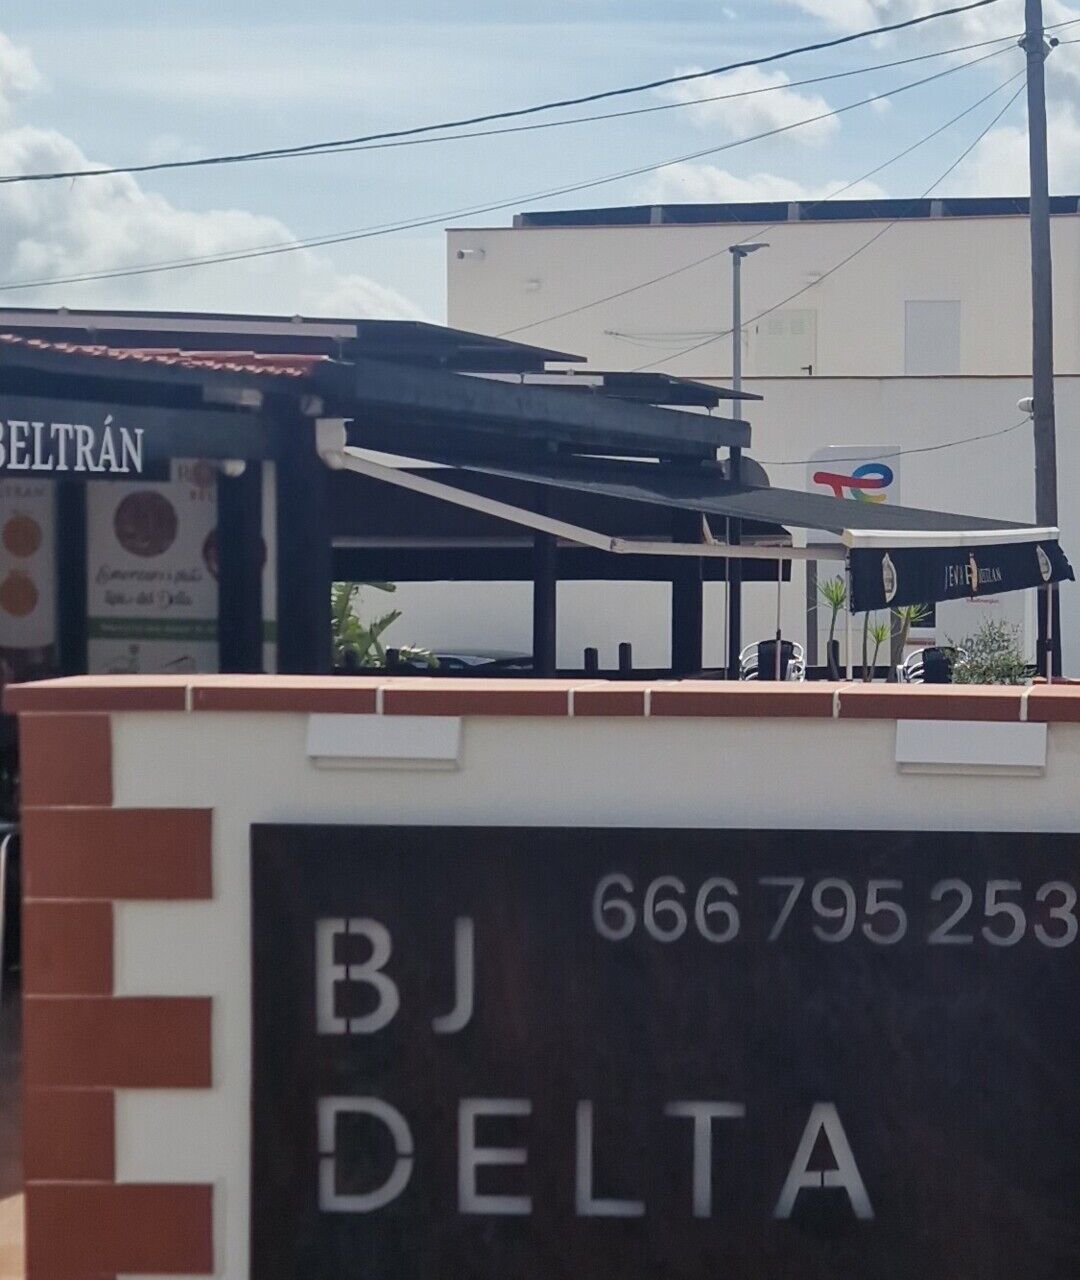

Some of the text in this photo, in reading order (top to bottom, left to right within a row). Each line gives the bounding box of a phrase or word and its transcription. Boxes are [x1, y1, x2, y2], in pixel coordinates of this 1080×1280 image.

[0, 414, 144, 473] ELTRÁN
[592, 872, 1079, 949] 666 795 253
[312, 915, 476, 1037] BJ
[316, 1095, 875, 1221] DELTA
